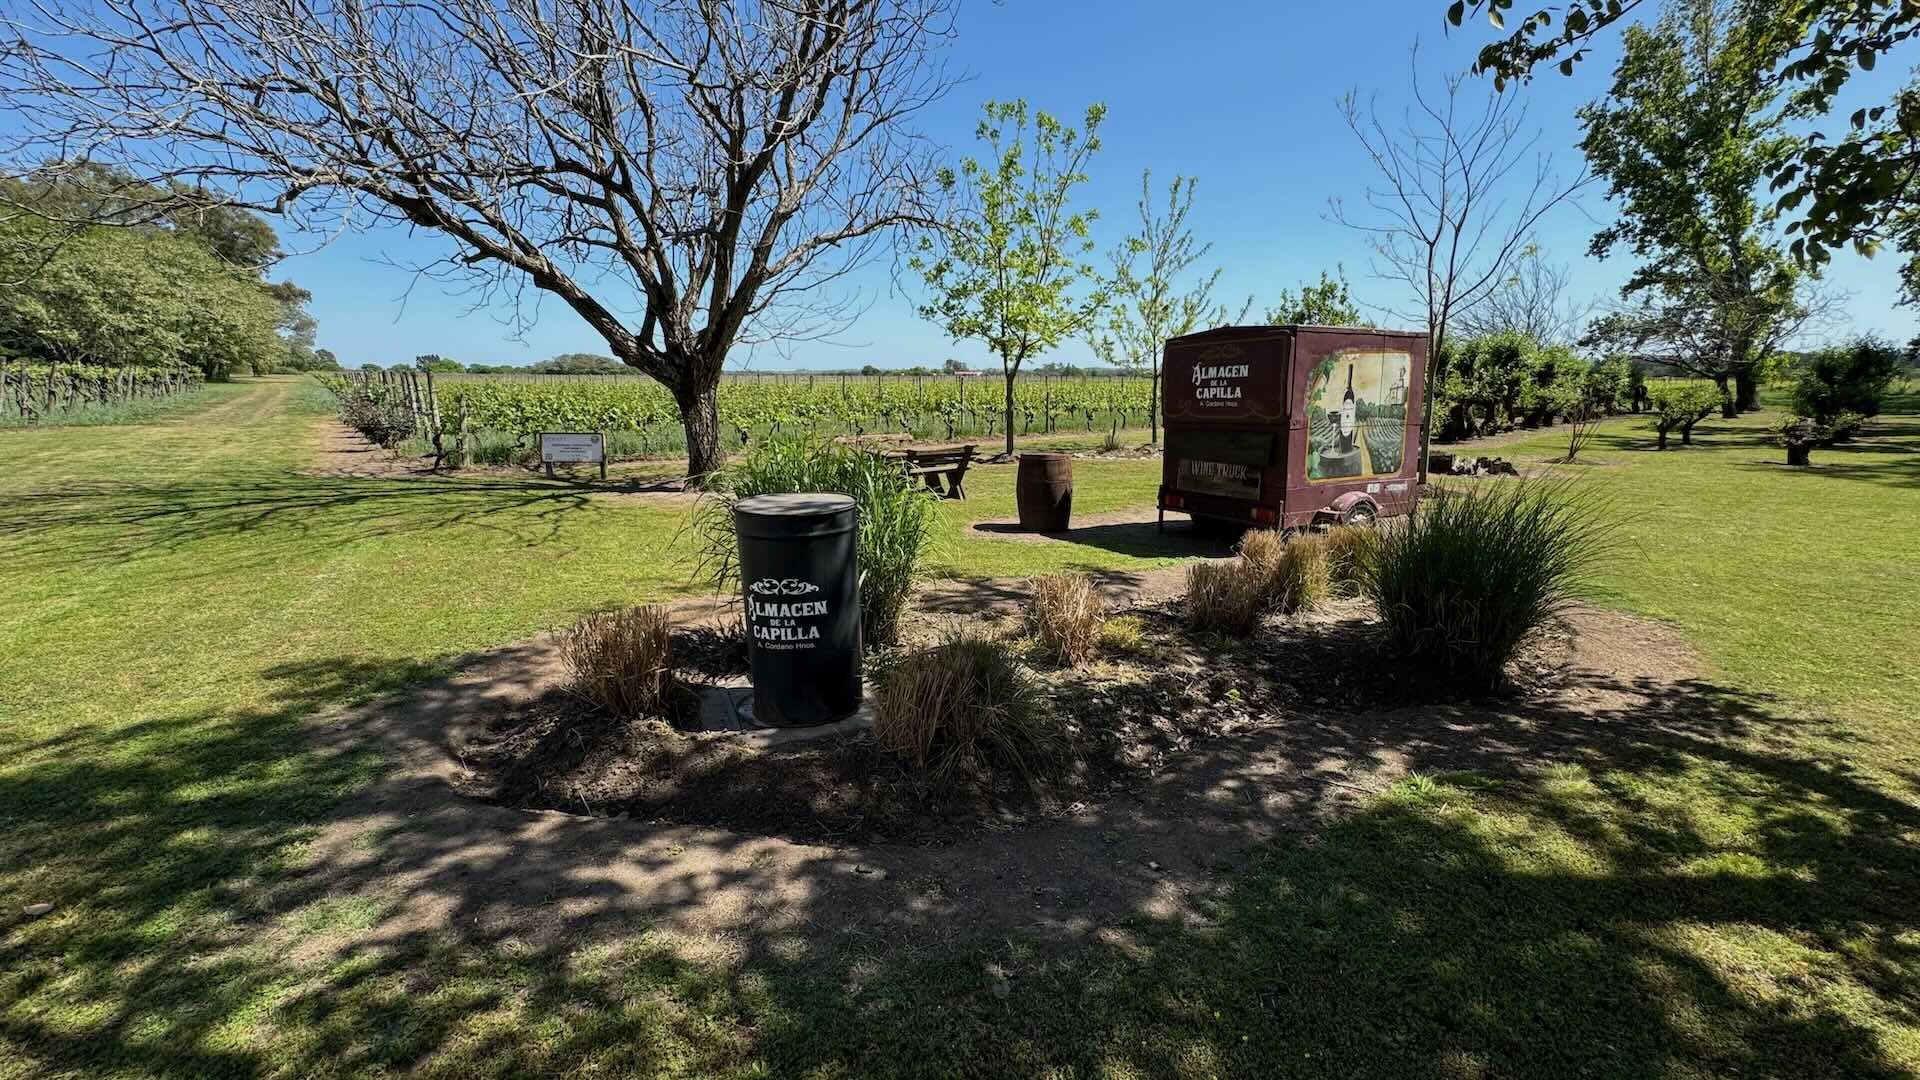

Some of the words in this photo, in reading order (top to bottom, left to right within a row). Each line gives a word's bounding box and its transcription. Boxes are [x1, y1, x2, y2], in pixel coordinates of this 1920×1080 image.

[1191, 362, 1249, 385] ALMACEN
[1196, 387, 1242, 399] CAPILLA
[1215, 463, 1248, 479] TRUCK
[747, 594, 828, 621] ALMACEN
[770, 619, 781, 627] DE
[784, 619, 796, 627] LA
[753, 625, 820, 640] CAPILLA
